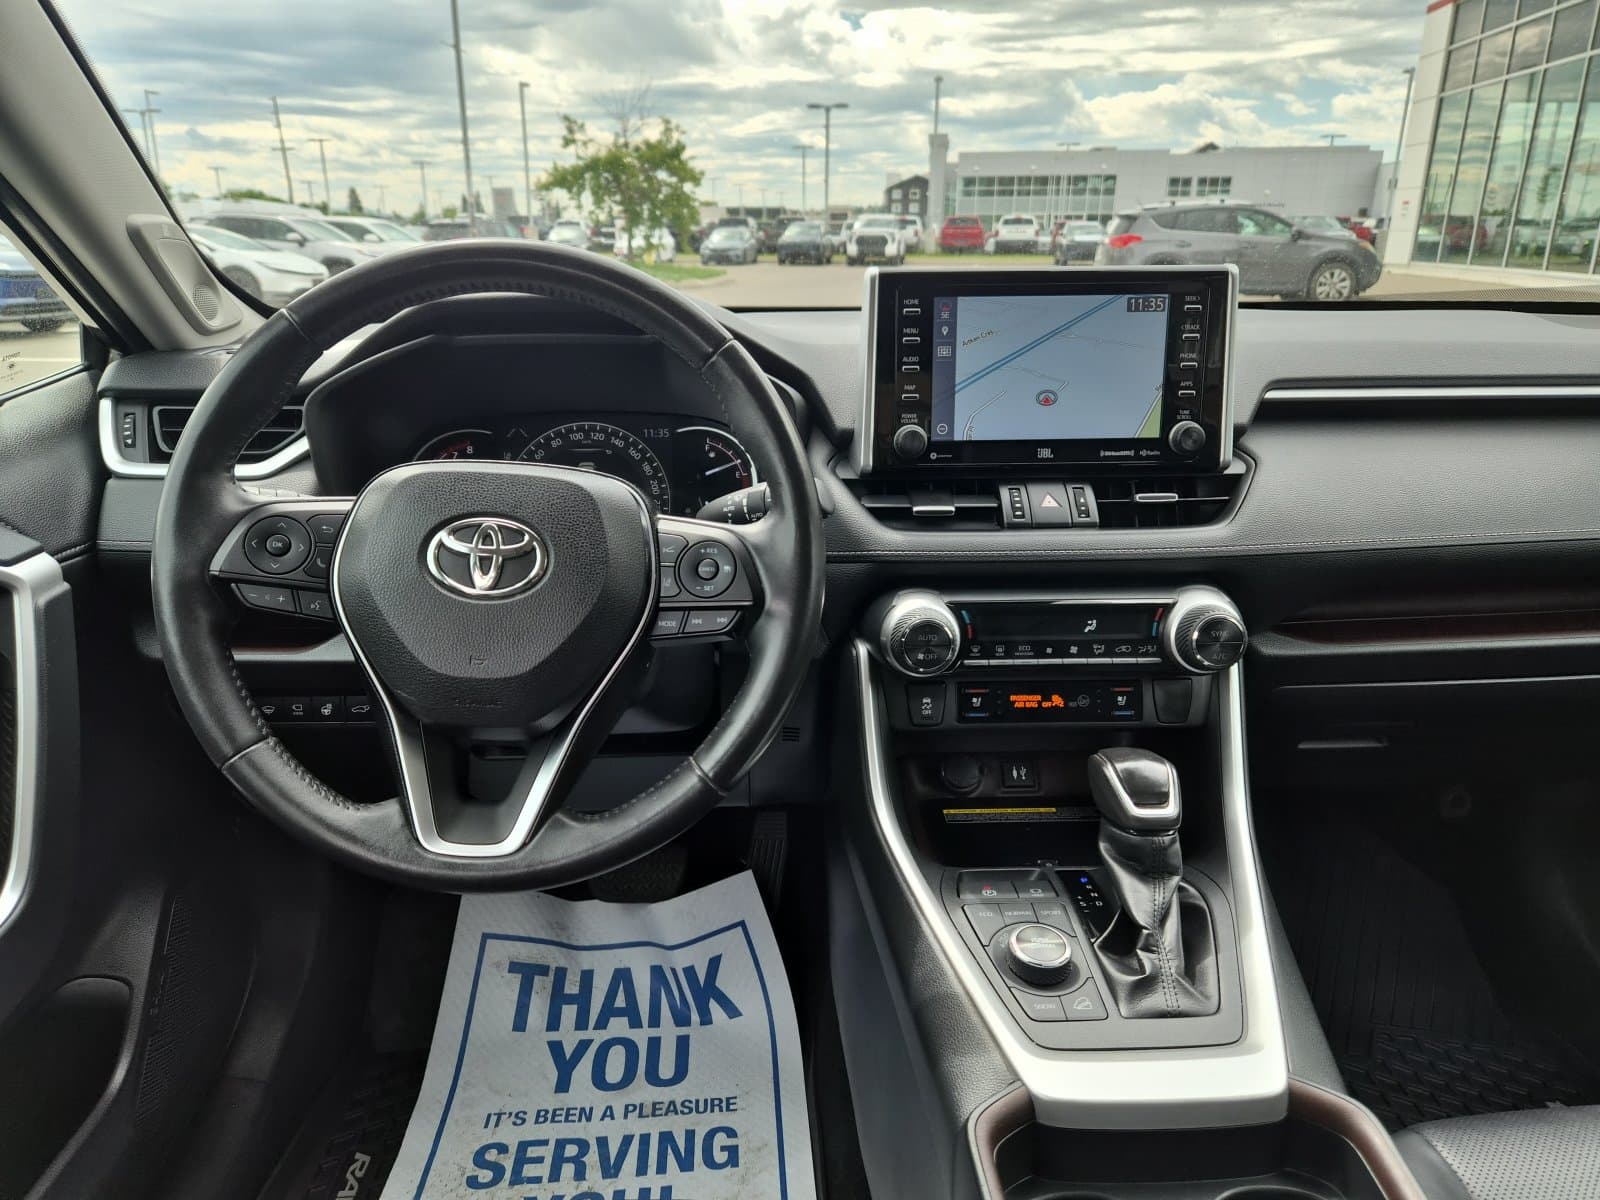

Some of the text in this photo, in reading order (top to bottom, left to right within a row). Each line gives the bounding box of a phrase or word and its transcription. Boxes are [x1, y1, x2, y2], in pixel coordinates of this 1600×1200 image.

[1130, 297, 1164, 311] 11:35
[568, 432, 584, 440] 100
[590, 432, 605, 441] 120
[642, 428, 670, 438] 11:35
[550, 438, 562, 448] 80
[610, 436, 625, 448] 140
[466, 445, 473, 454] 8
[628, 446, 642, 460] 160
[705, 444, 710, 452] F
[1037, 448, 1054, 459] JBL
[452, 451, 458, 460] 7
[534, 449, 545, 460] 60
[641, 461, 653, 476] 180
[735, 471, 741, 479] E
[649, 479, 660, 495] 200
[507, 953, 743, 1033] THANK
[546, 1034, 691, 1094] YOU
[483, 1096, 738, 1129] IT'S BEEN A PLEASURE
[465, 1125, 740, 1190] SERVING
[335, 1151, 372, 1200] RA
